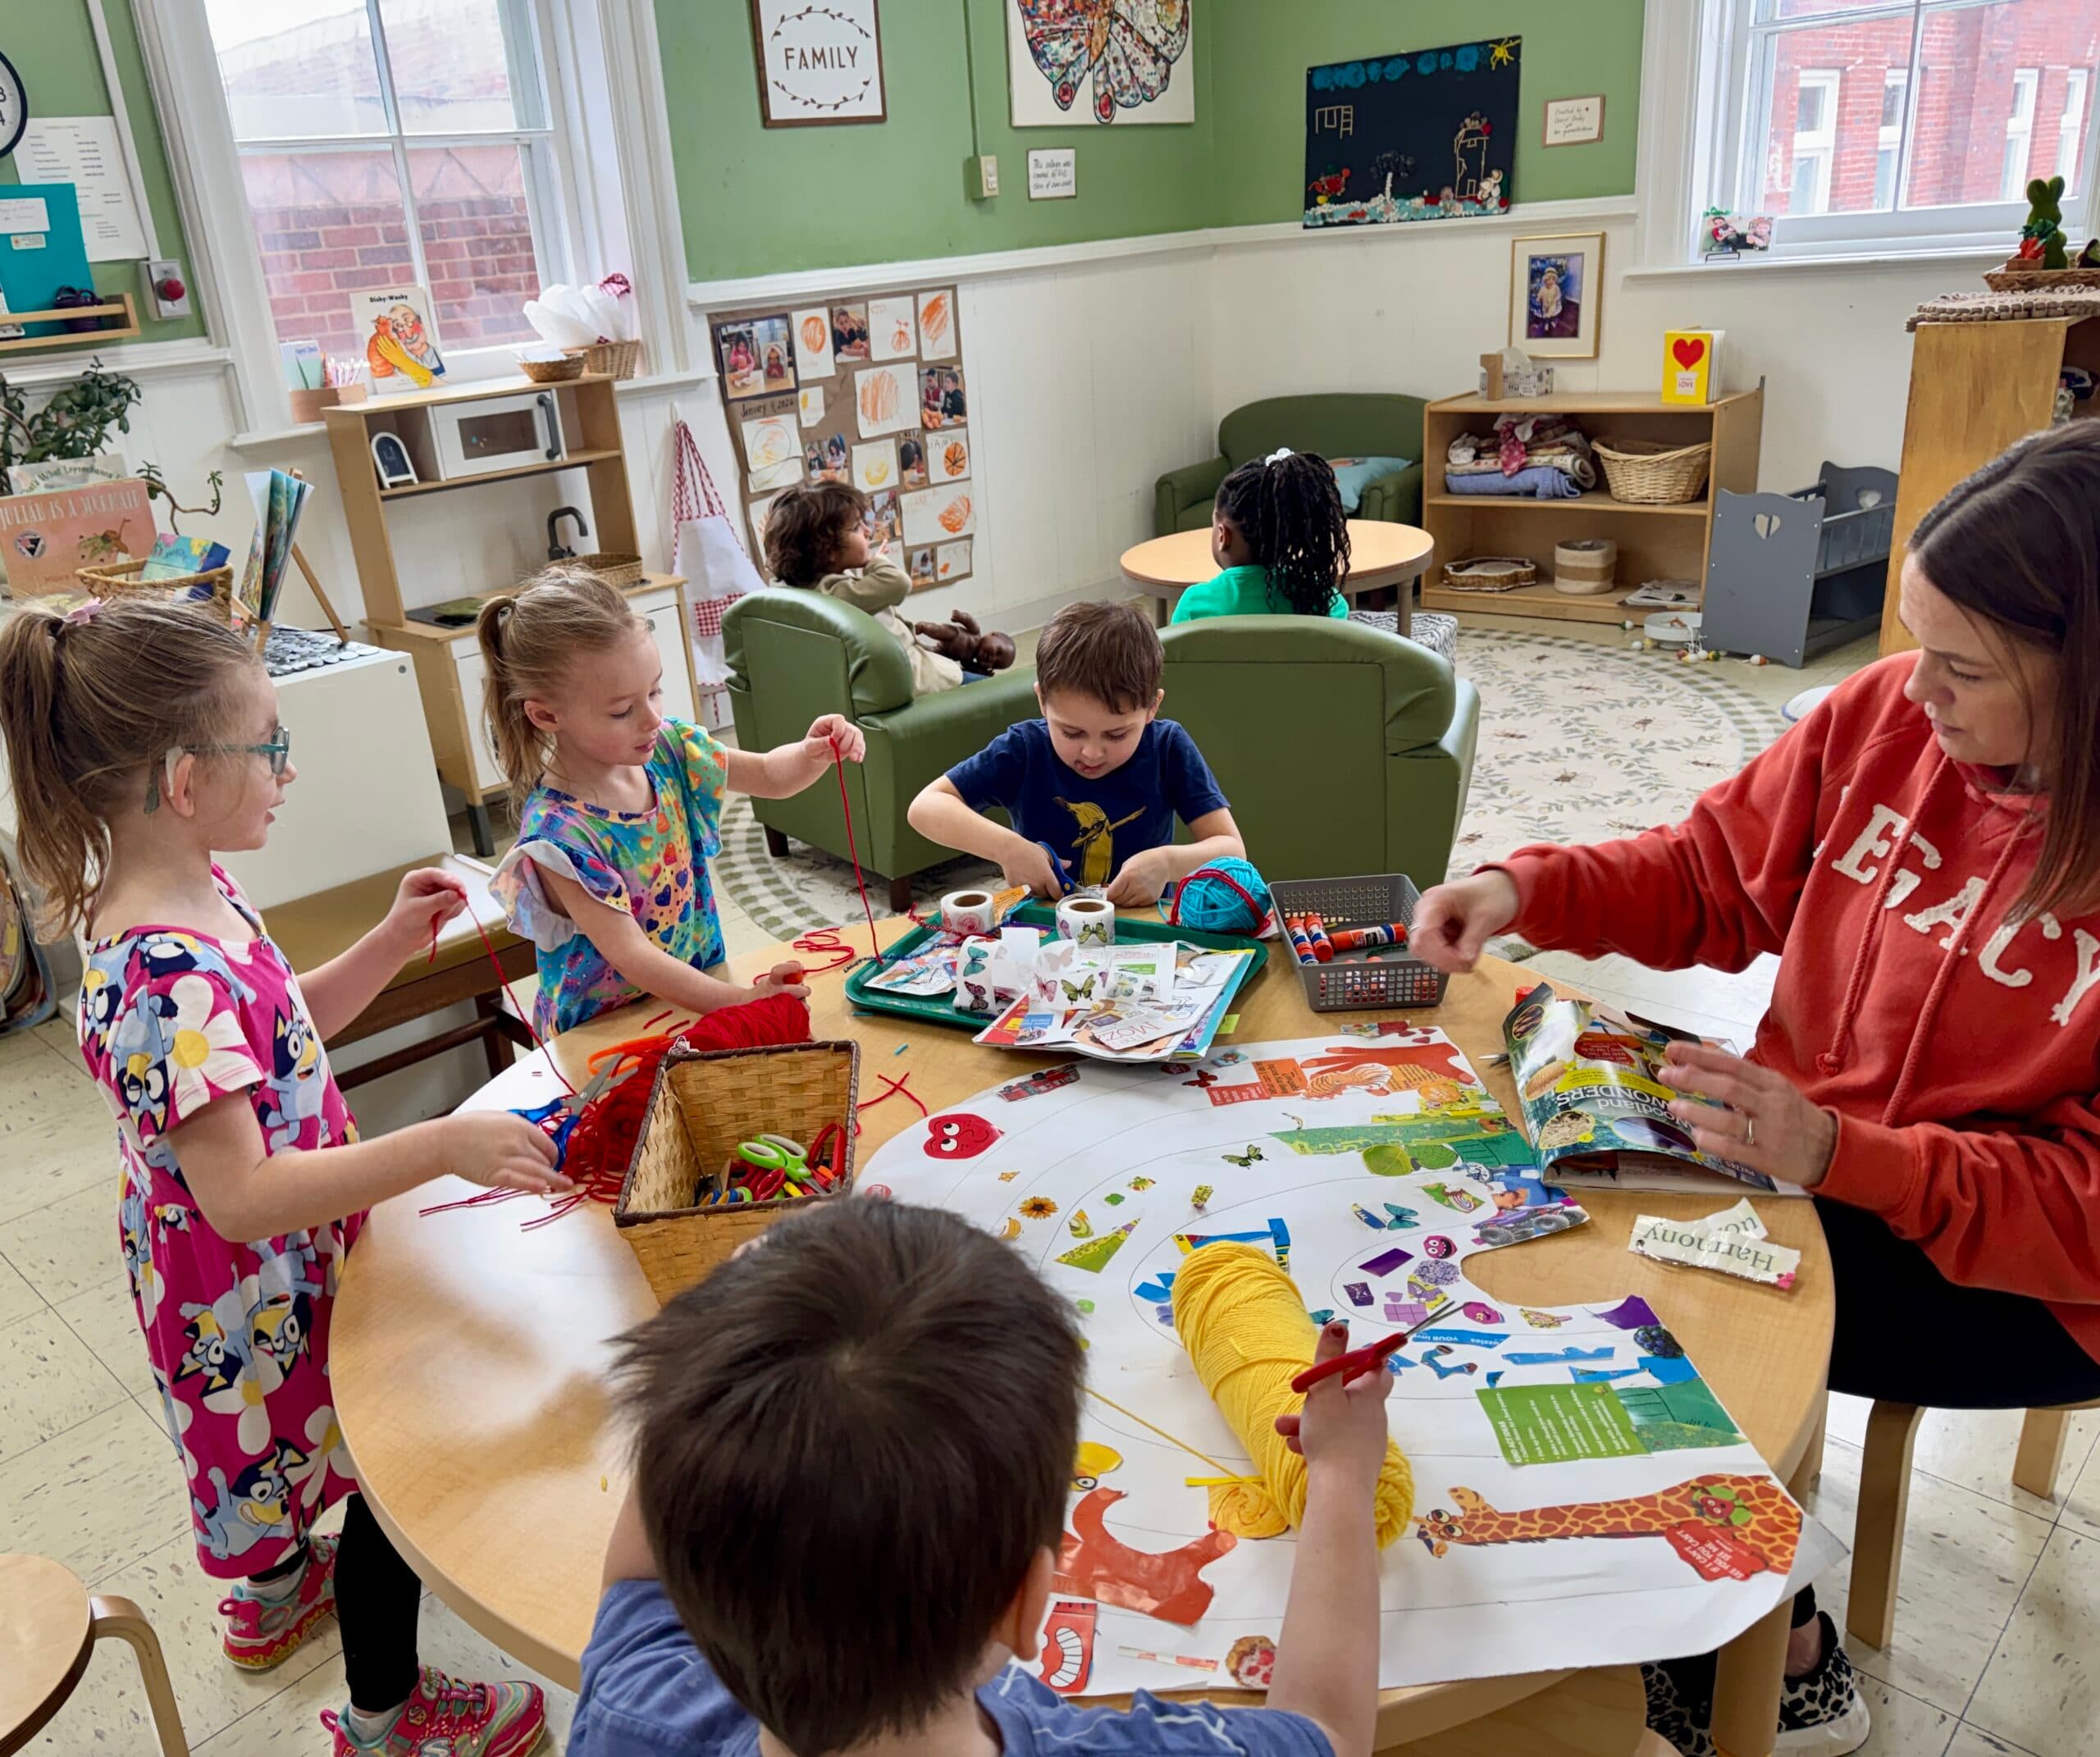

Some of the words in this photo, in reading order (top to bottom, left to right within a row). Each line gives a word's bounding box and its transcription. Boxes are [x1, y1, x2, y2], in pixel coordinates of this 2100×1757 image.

[784, 46, 857, 71] FAMILY
[1678, 381, 1694, 389] LOVE
[49, 499, 65, 520] IS
[68, 497, 78, 518] A
[1554, 1084, 1670, 1108] WONDERS
[1642, 1222, 1775, 1272] Harmony
